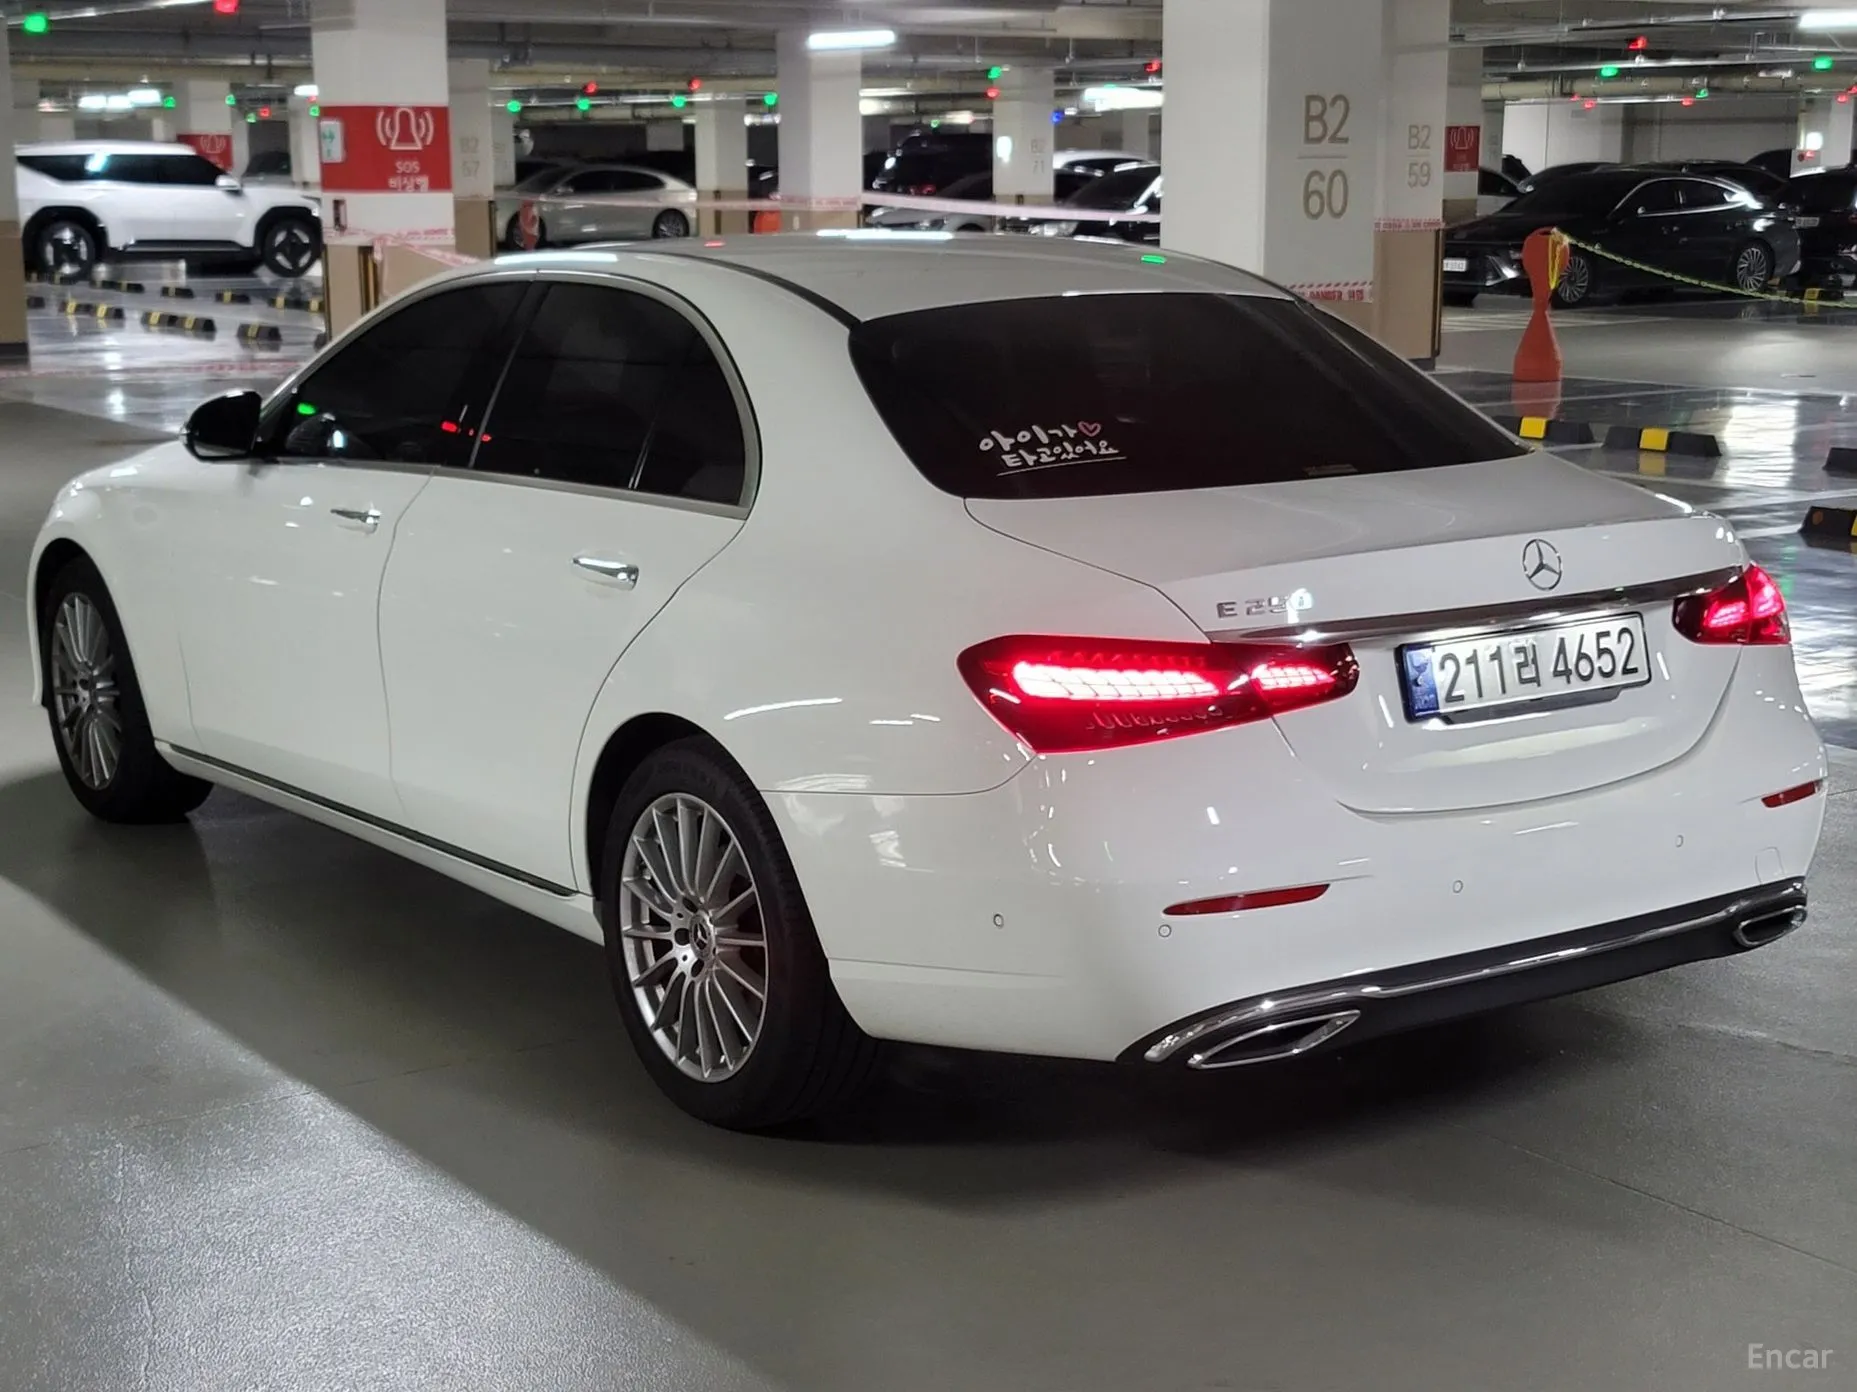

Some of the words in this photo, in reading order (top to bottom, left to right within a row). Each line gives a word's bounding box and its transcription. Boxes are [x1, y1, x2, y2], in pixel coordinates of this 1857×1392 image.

[1303, 94, 1350, 144] B2
[1407, 124, 1431, 150] B2
[395, 160, 420, 174] SOS
[1407, 162, 1431, 189] 59
[1303, 168, 1349, 220] 60
[979, 424, 1077, 451] 아이가
[1216, 601, 1238, 618] E
[1552, 627, 1639, 684] 4652
